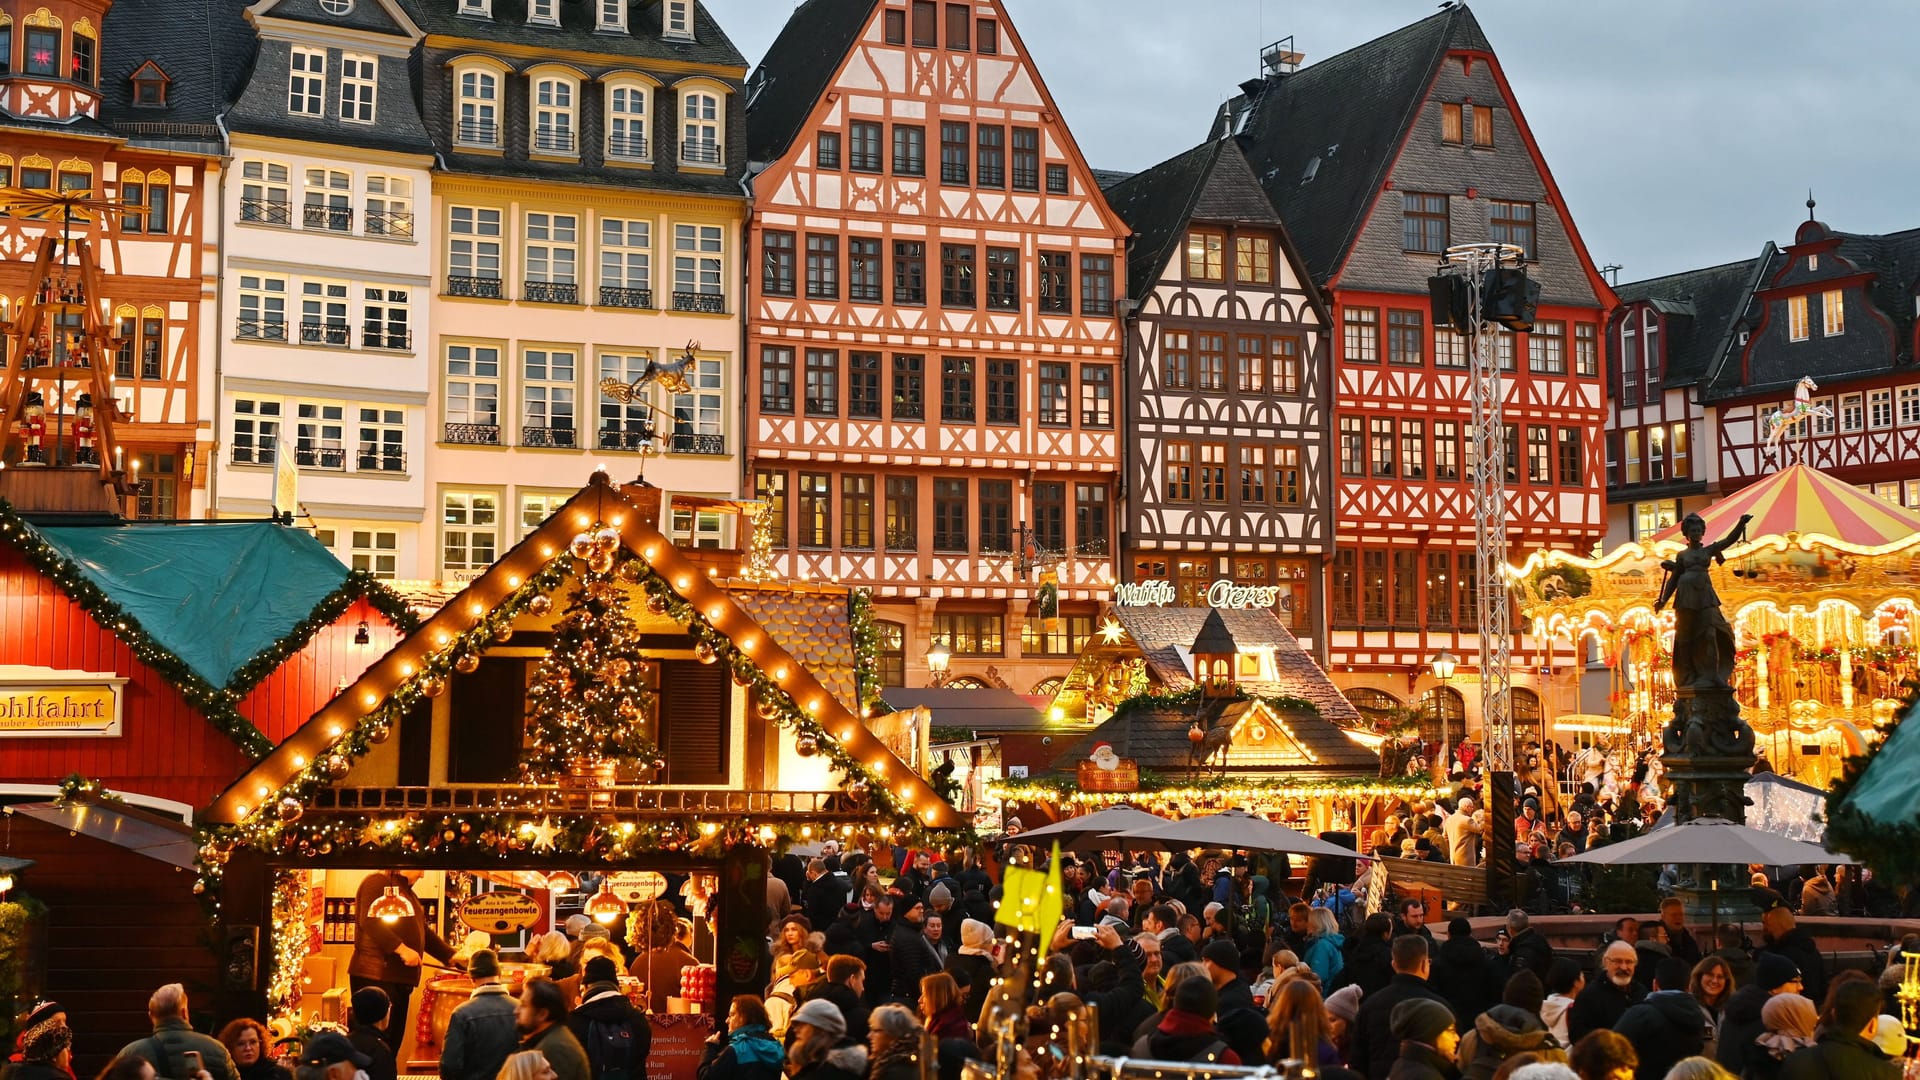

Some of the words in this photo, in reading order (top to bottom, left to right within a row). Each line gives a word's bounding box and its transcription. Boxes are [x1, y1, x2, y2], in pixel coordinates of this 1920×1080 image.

[454, 571, 484, 582] Souve
[1114, 579, 1176, 608] Waffeln
[1207, 579, 1280, 610] Crepes
[37, 720, 82, 728] Germany
[464, 905, 537, 916] Feuerzangenbowle
[651, 1060, 665, 1068] Rum
